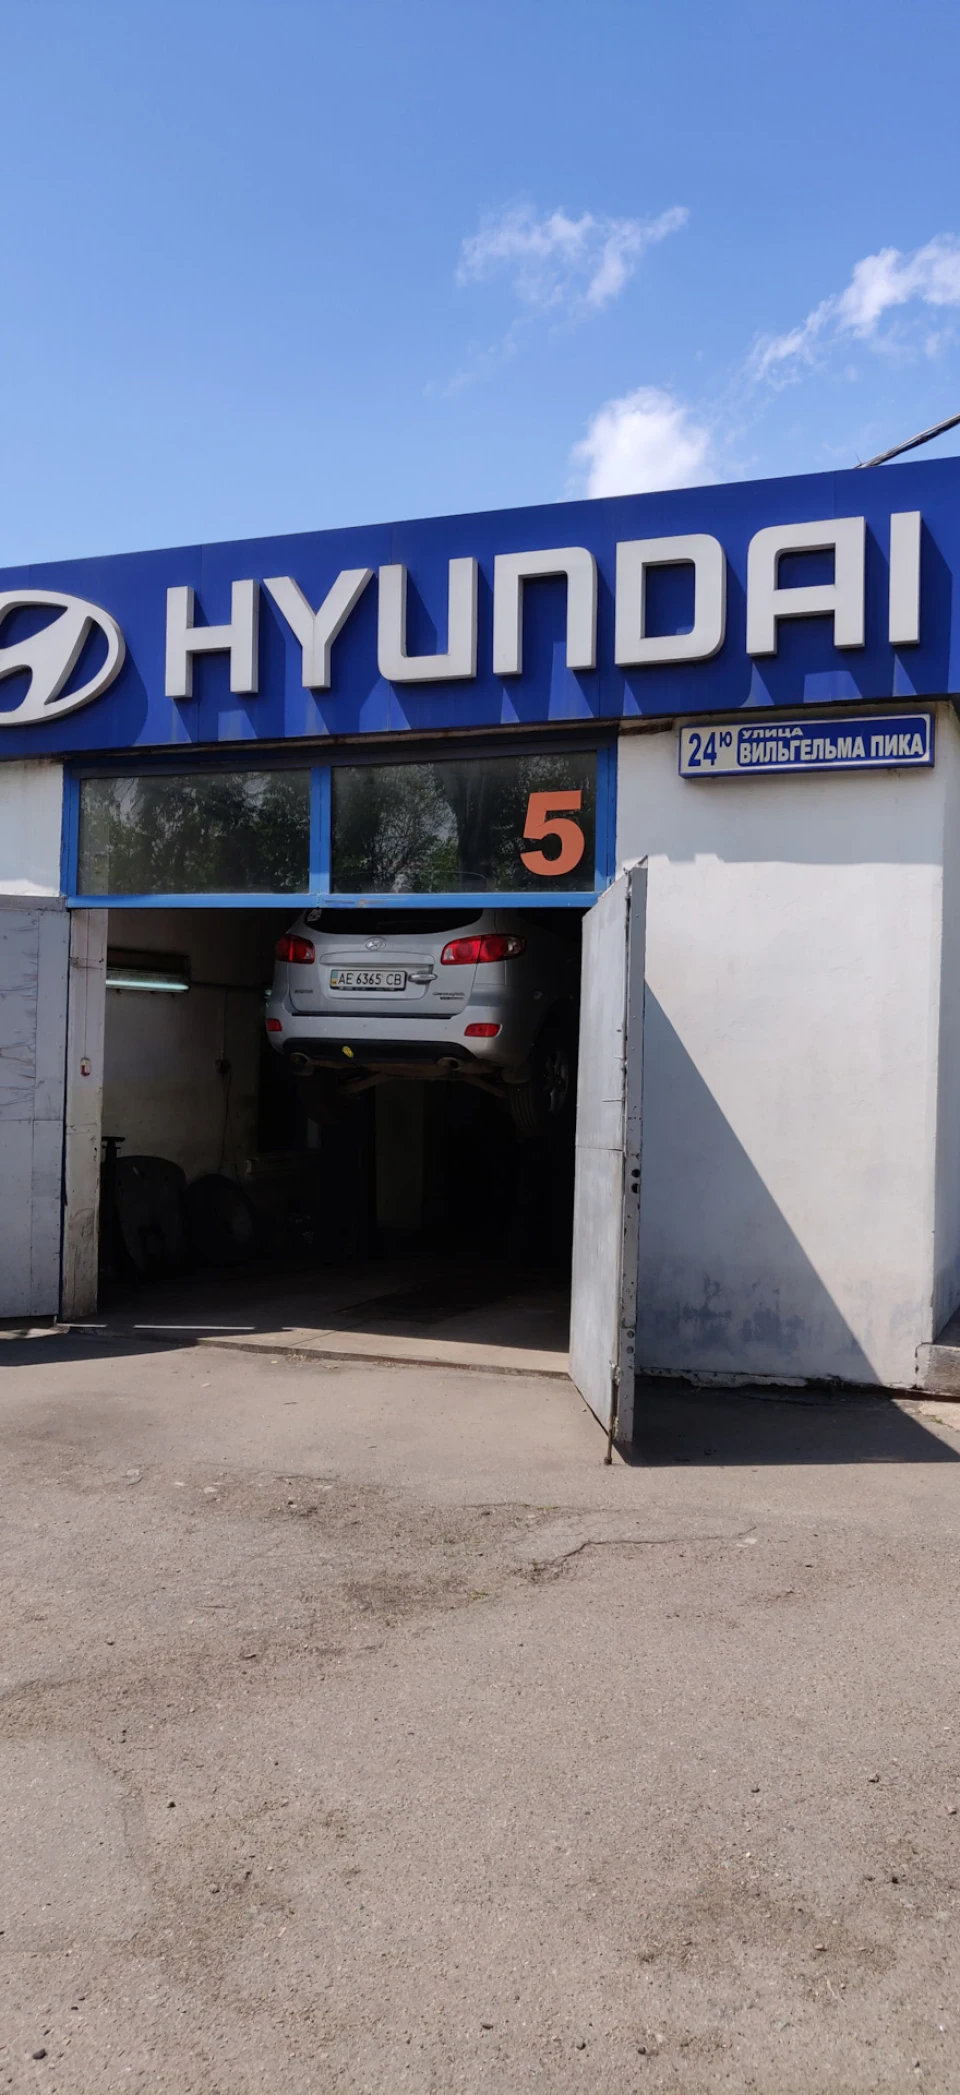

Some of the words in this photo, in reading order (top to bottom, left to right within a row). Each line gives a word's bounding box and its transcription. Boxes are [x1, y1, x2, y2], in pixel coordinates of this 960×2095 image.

[165, 511, 921, 698] HYUNDAI
[739, 736, 865, 764] ВИЛЬГЕЛЬМА
[870, 733, 923, 757] ПИКА
[741, 727, 803, 739] УЛИЦА
[521, 790, 585, 876] 5
[338, 973, 354, 985] AE
[356, 973, 381, 985] 6365
[386, 974, 402, 986] CB
